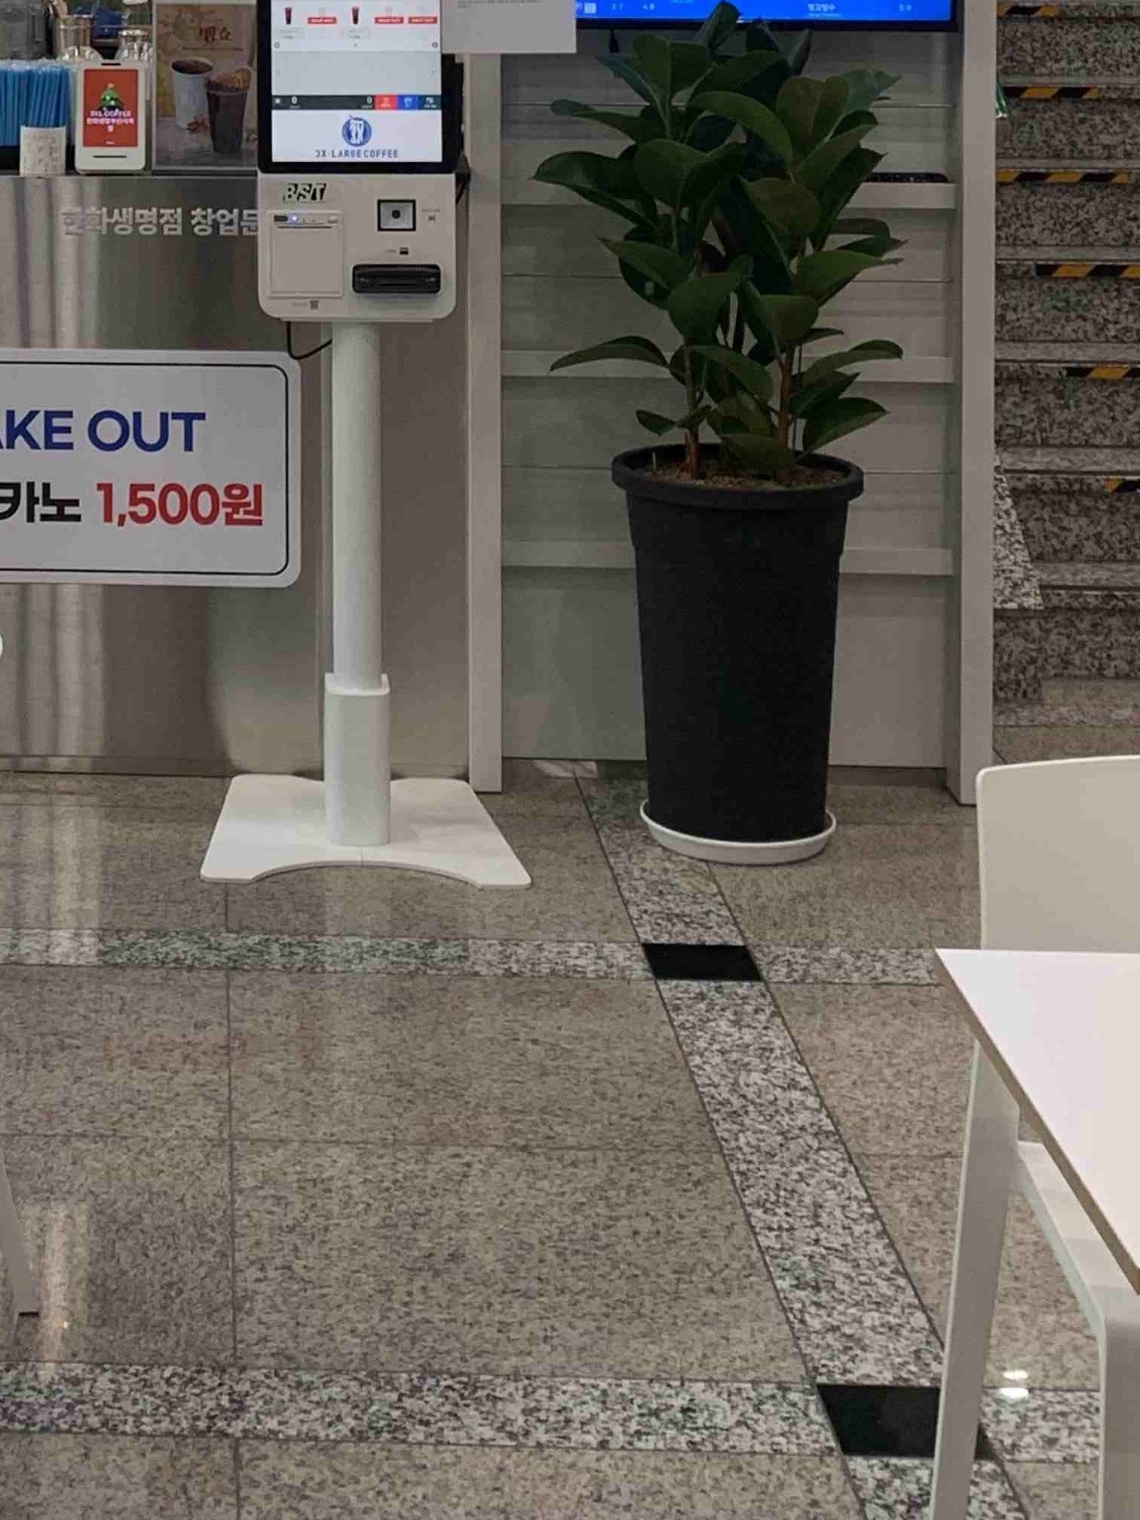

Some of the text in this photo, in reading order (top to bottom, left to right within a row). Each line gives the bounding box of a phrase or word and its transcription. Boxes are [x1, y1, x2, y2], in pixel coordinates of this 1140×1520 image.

[363, 149, 398, 158] COFFEE
[87, 410, 206, 453] OUT
[97, 482, 263, 527] 1,500원
